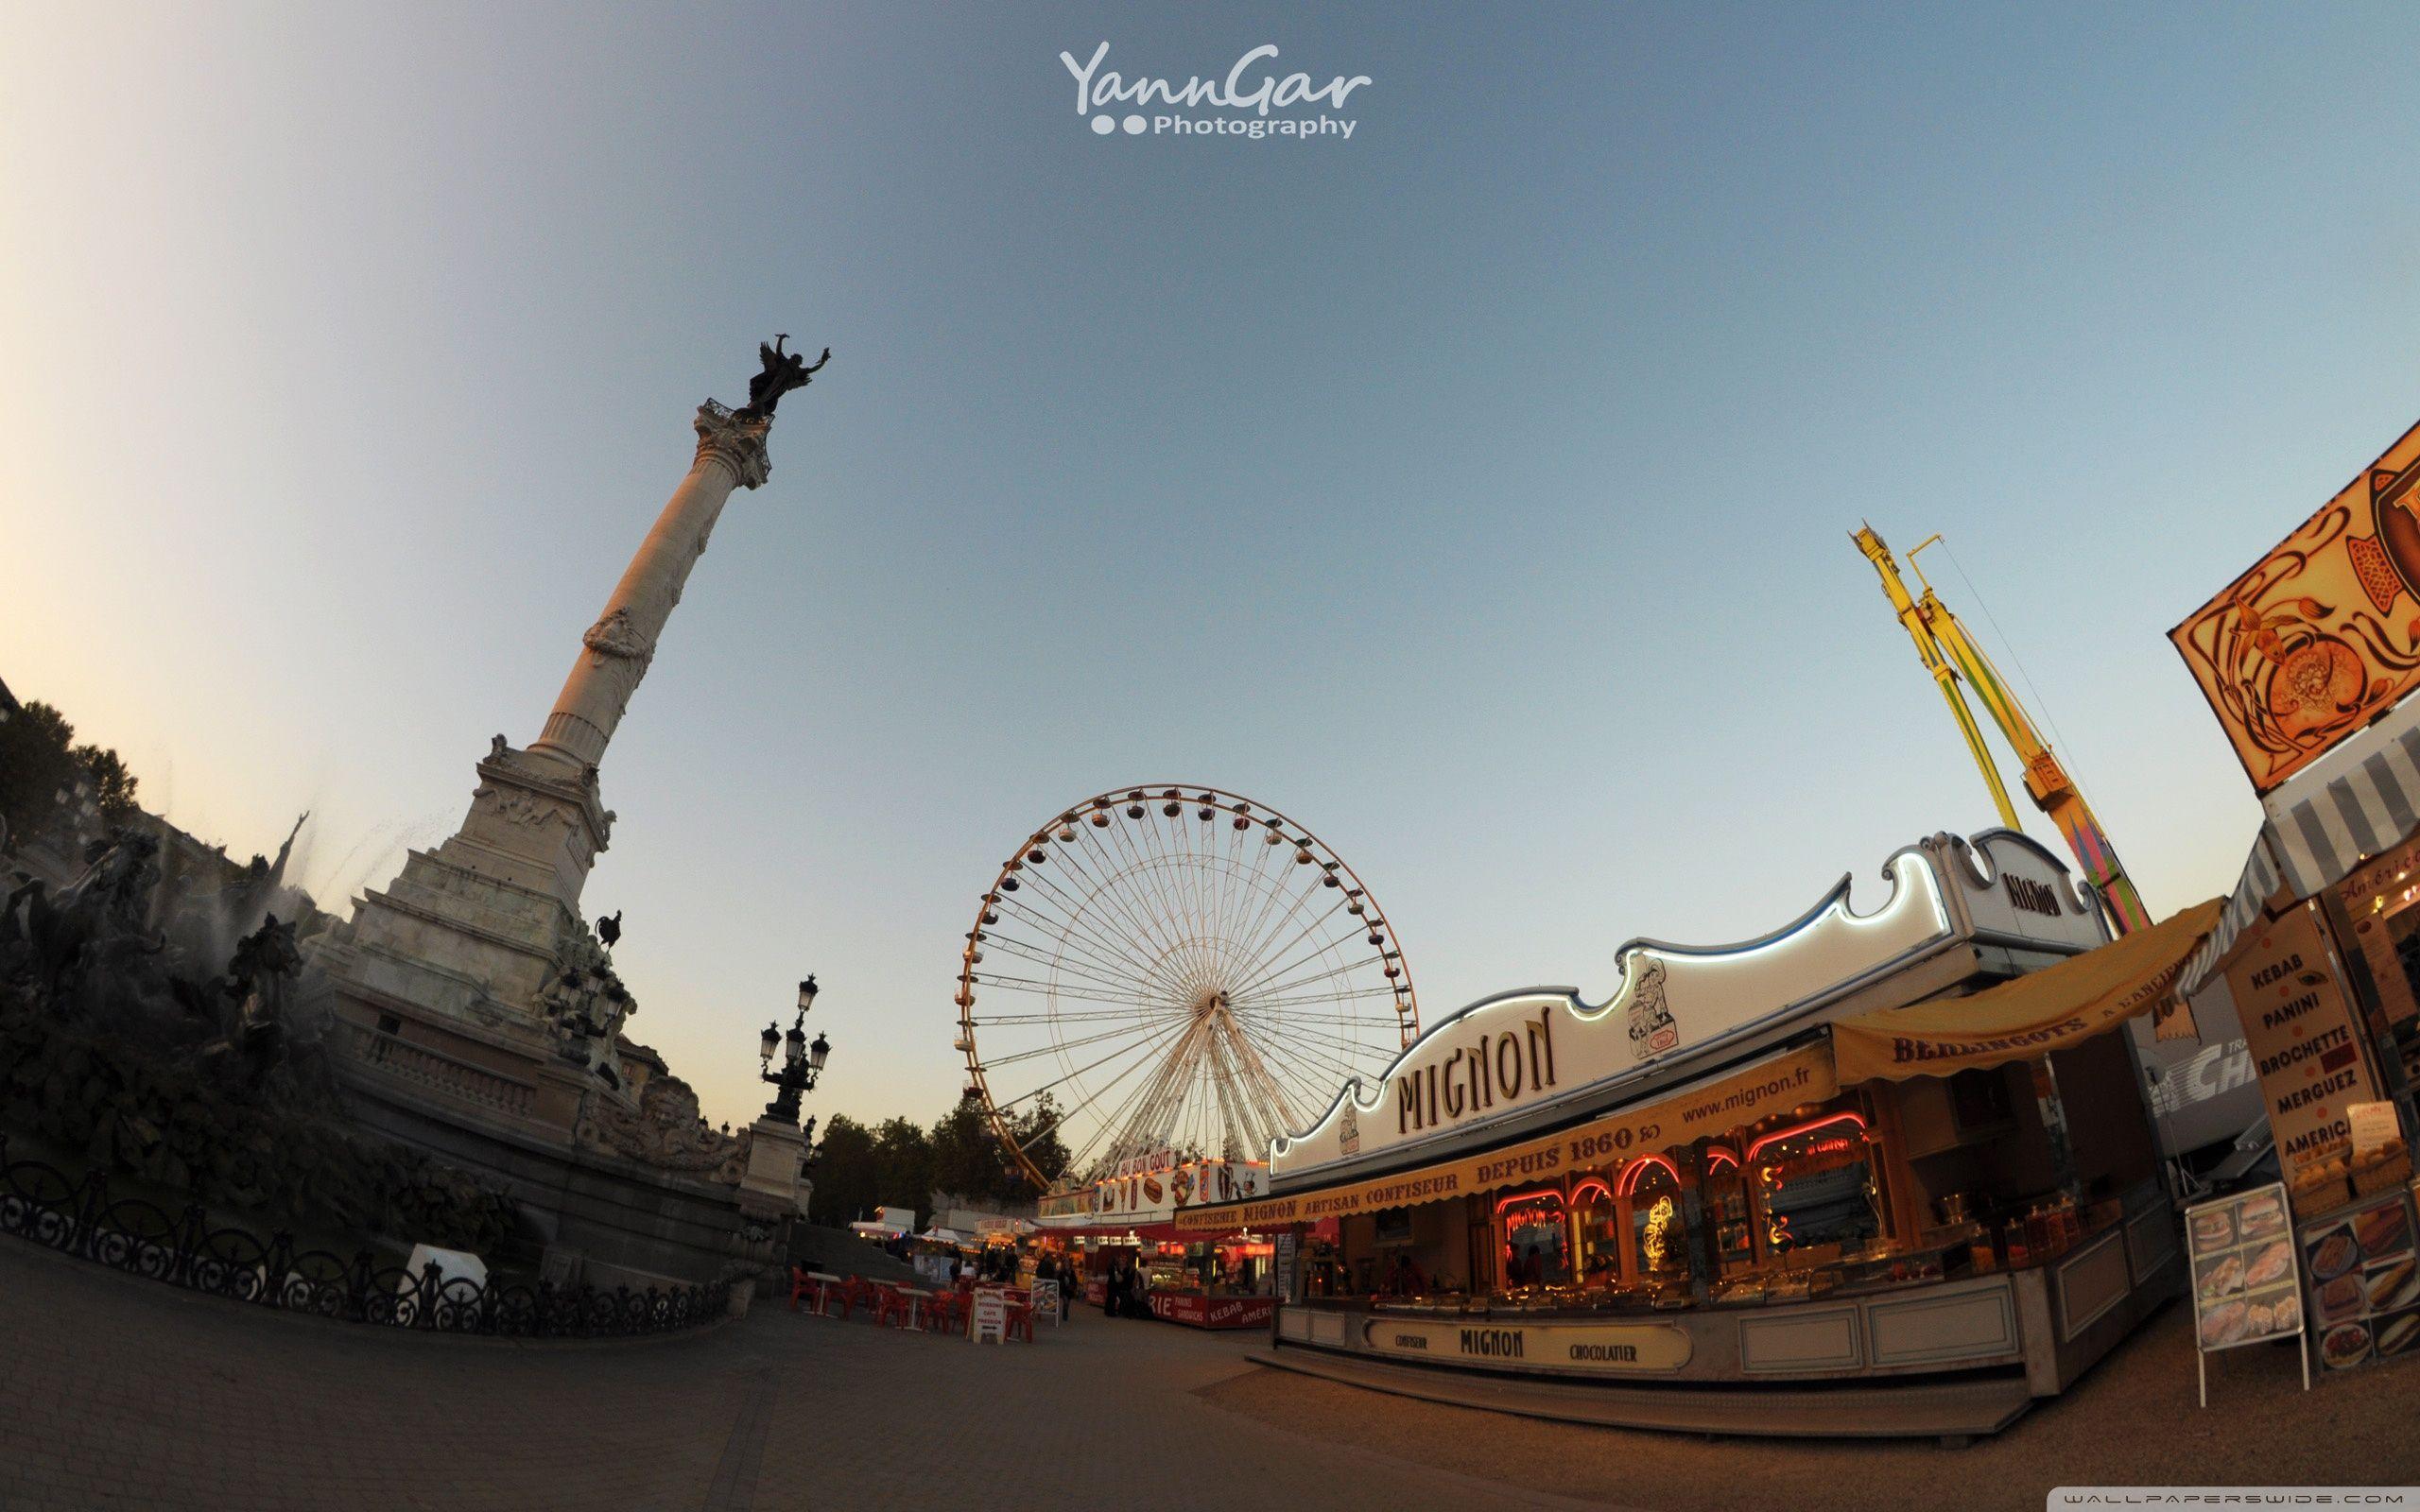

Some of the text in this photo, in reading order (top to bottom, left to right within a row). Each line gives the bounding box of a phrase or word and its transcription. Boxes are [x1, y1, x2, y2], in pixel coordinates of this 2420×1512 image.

[2250, 954, 2304, 990] KEBAB
[2263, 993, 2320, 1029] PANINI
[1892, 1018, 2088, 1063] BERLINGOTS
[2258, 1024, 2351, 1076] BROCHETTE
[1396, 1005, 1556, 1135] MIGNON
[1682, 1068, 1810, 1124] www.mignon.fr
[2277, 1070, 2358, 1114] MERGUEZ
[1132, 1156, 1147, 1174] BON
[1150, 1150, 1171, 1169] GOUT
[1182, 1127, 1634, 1226] CONFISERIE MIGNON ARTISAN CONFISEUR DEPUIS 1860
[1210, 1301, 1243, 1322] KEBAB
[1395, 1334, 1427, 1350] CONFISEUR
[1461, 1329, 1524, 1358] MIGNON
[1569, 1344, 1638, 1363] CHOCOLATIER
